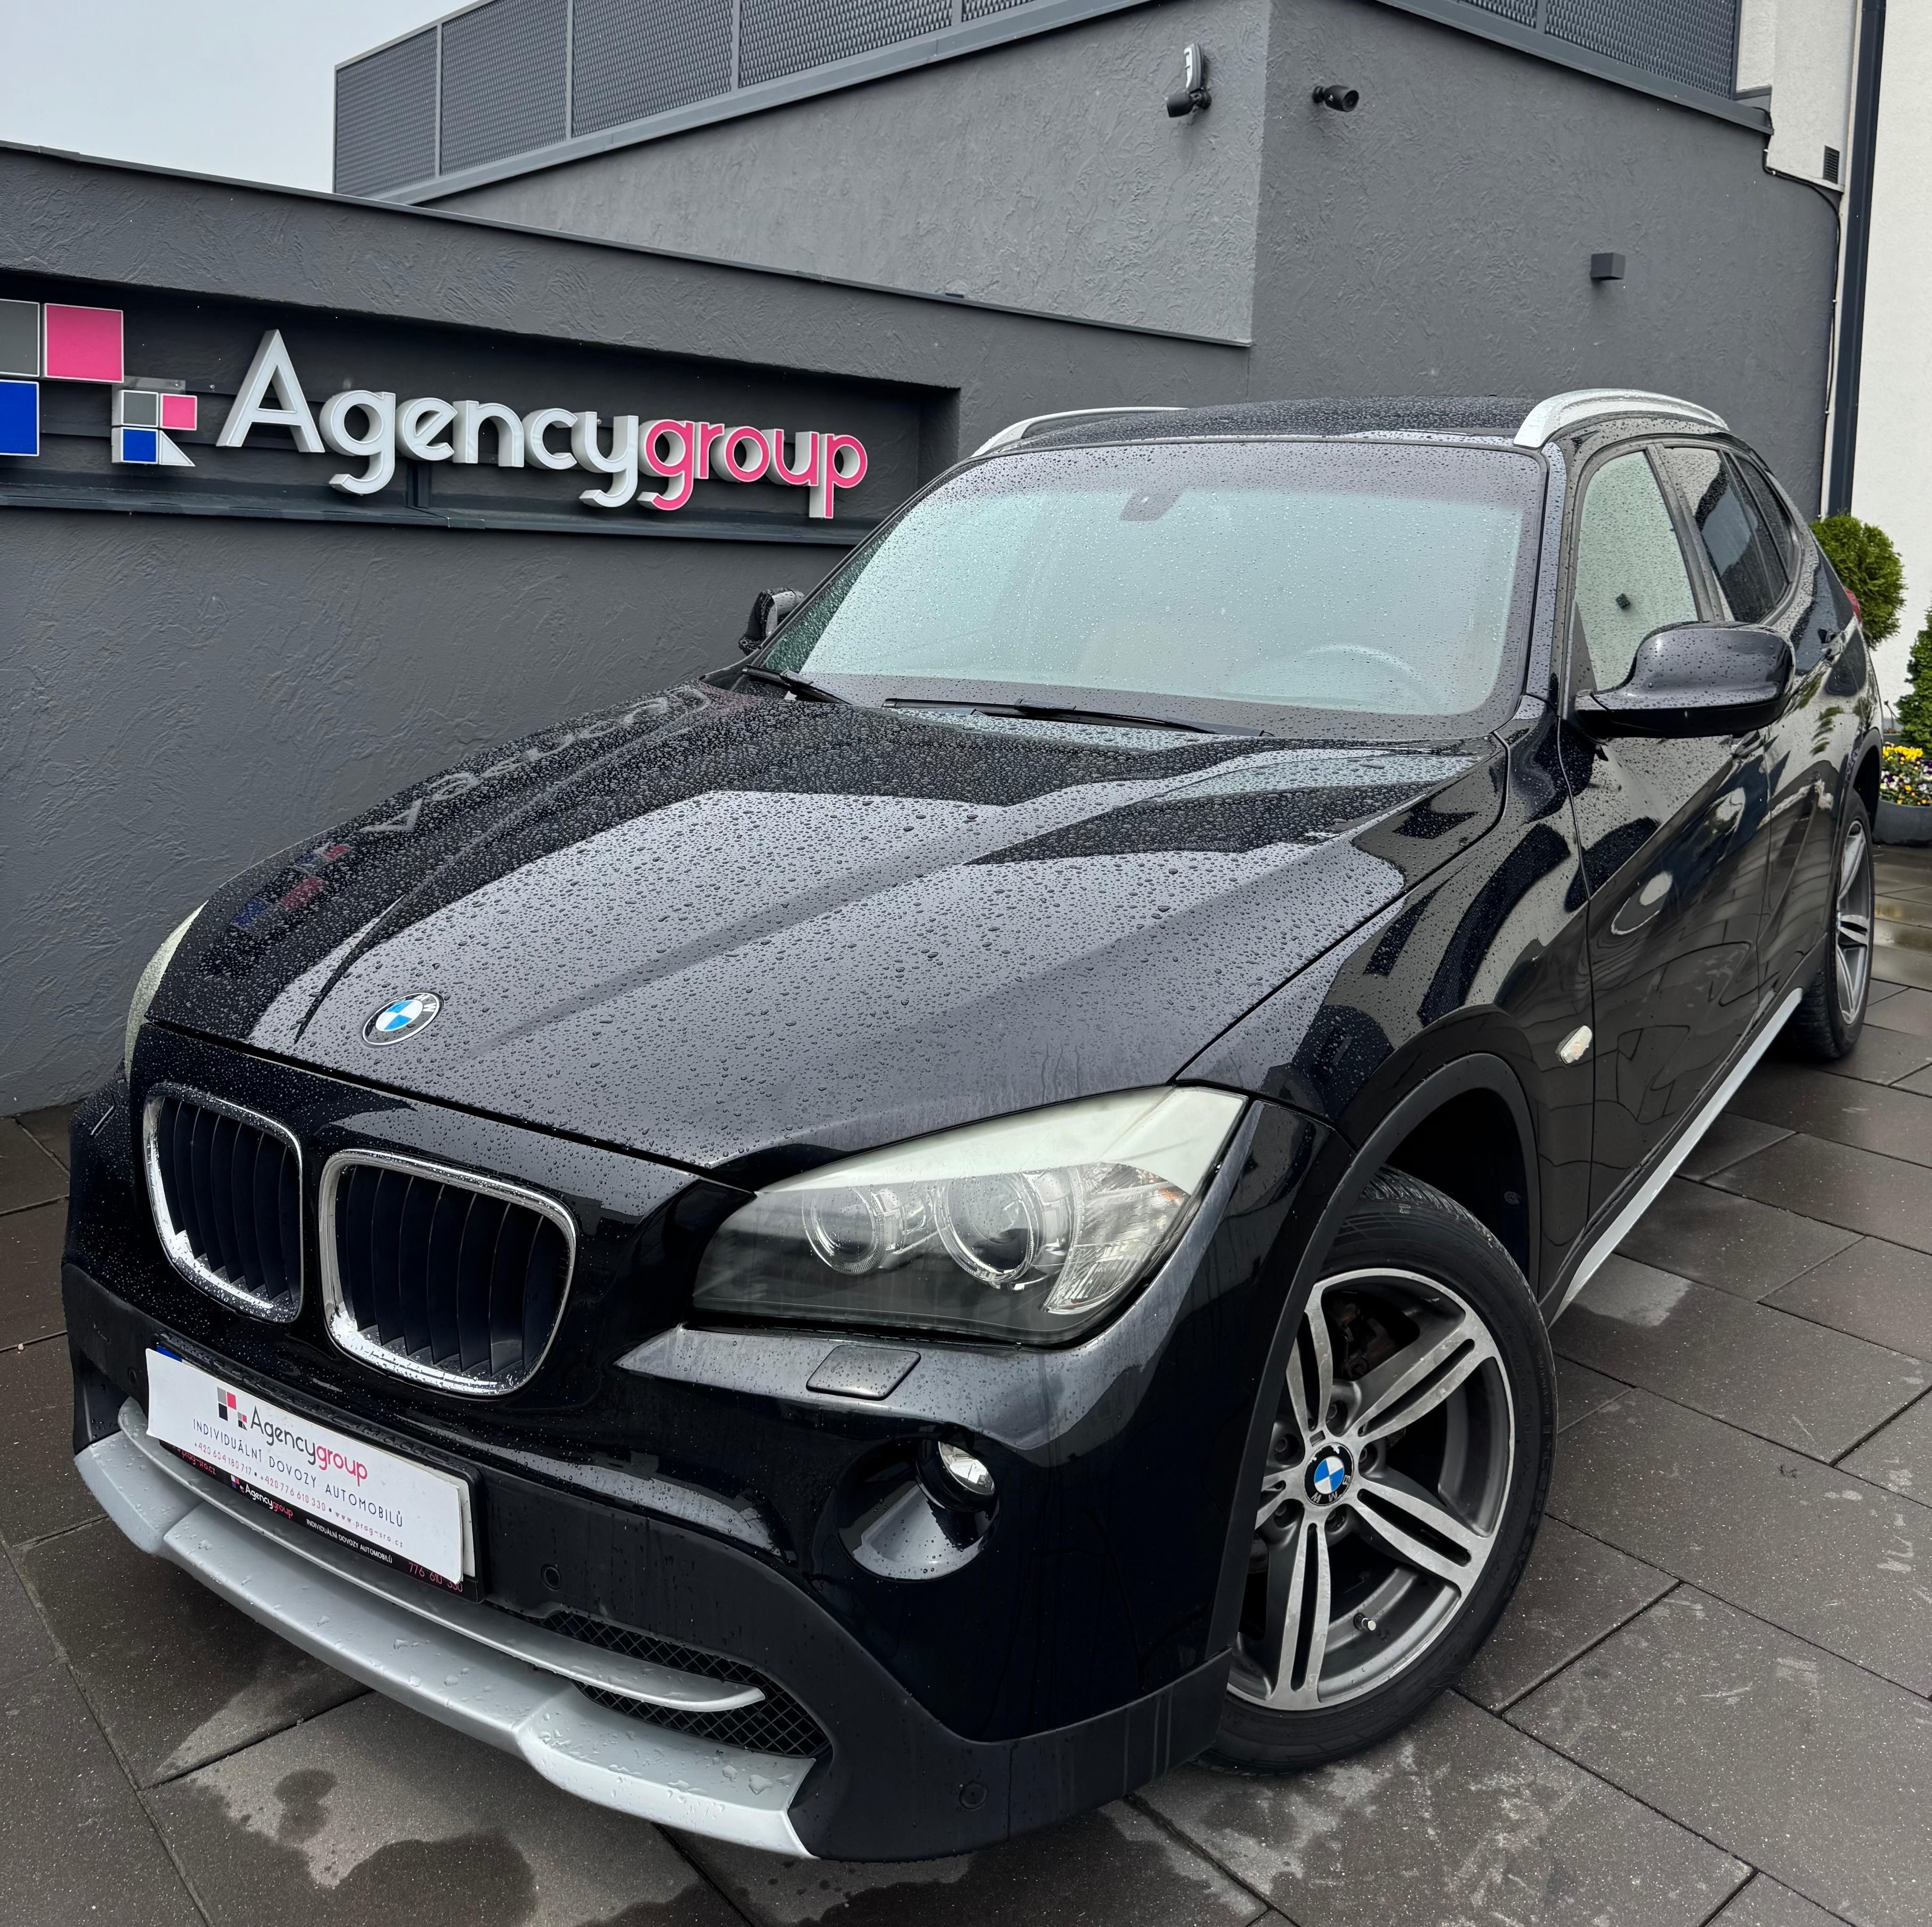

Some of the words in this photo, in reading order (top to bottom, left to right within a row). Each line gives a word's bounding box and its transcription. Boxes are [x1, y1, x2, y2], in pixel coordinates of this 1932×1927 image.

[215, 328, 868, 519] Agencygroup
[228, 1457, 239, 1469] 180
[241, 1463, 251, 1475] 717
[281, 1483, 294, 1496] 776
[297, 1491, 309, 1503] 610
[312, 1498, 325, 1511] 330
[250, 1405, 368, 1487] Agencygroup
[269, 1456, 316, 1488] DOVOZY
[325, 1484, 402, 1527] AUTOMOBILŮ
[1310, 1474, 1351, 1503] BMW
[245, 1484, 293, 1519] Agencygroup
[338, 1534, 358, 1549] DOVOZY
[360, 1544, 392, 1564] AUTOMOBILŮ
[408, 1562, 425, 1578] 776
[429, 1571, 442, 1585] 610
